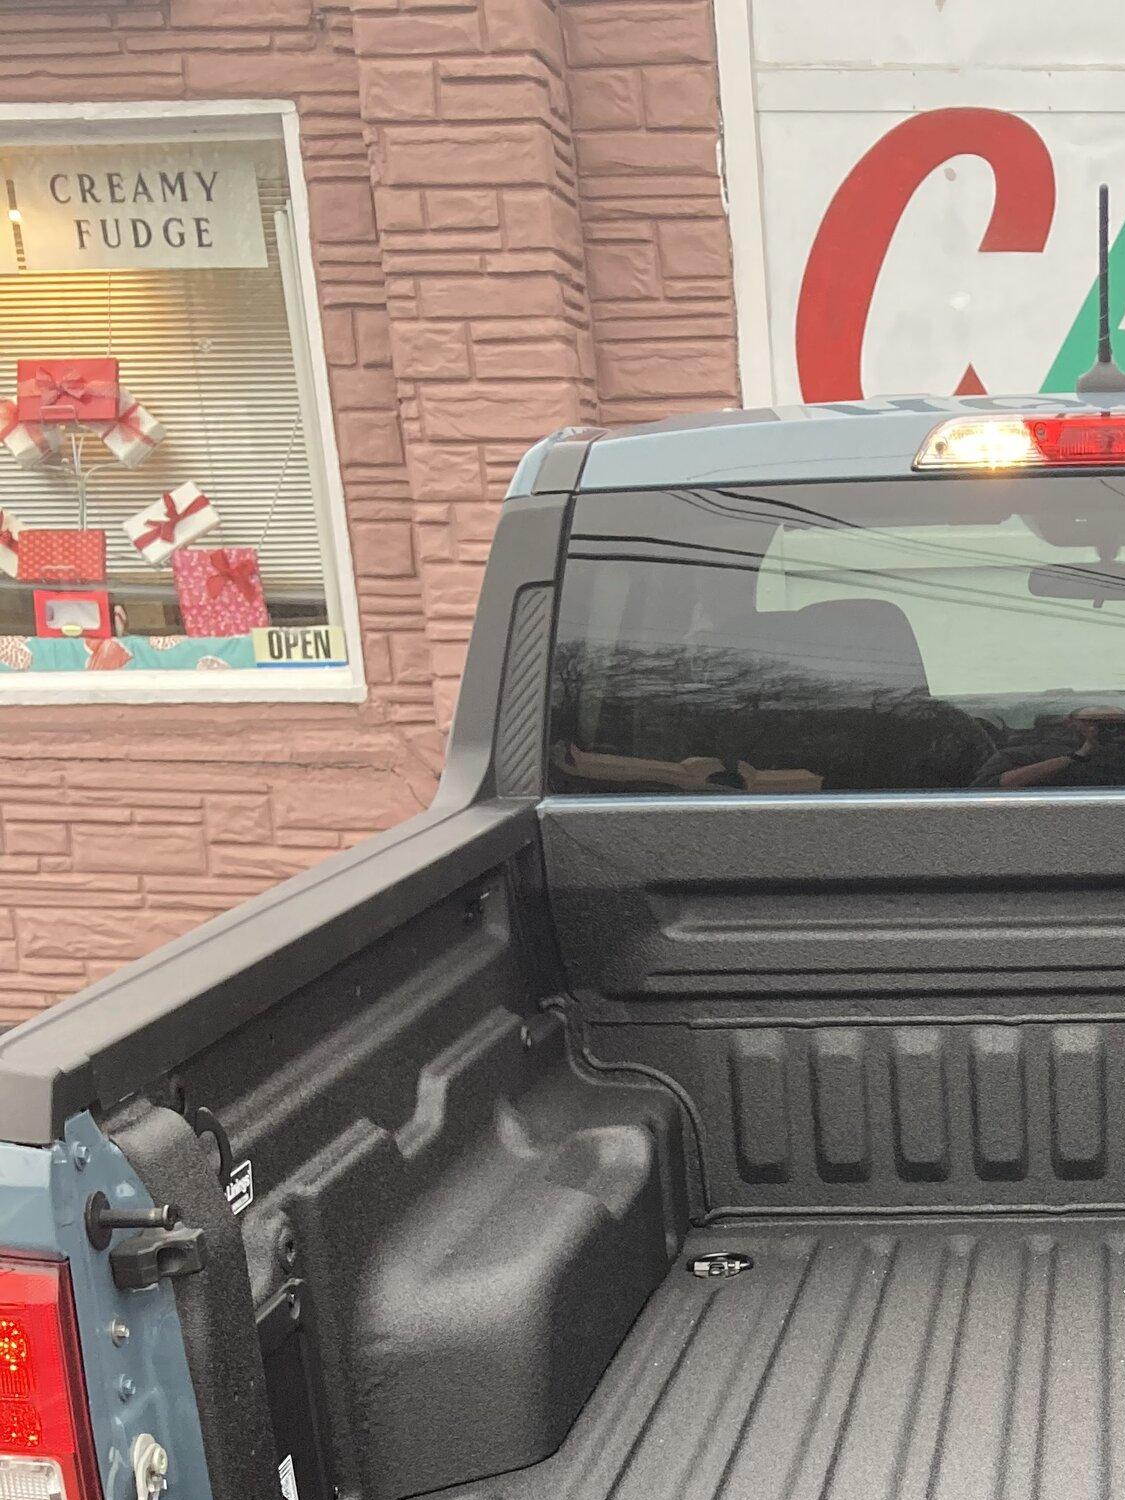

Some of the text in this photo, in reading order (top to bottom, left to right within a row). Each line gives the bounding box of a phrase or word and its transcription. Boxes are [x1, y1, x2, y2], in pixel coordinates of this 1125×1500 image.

[50, 171, 218, 204] CREAMY
[75, 217, 213, 250] FUDGE
[268, 629, 332, 660] OPEN
